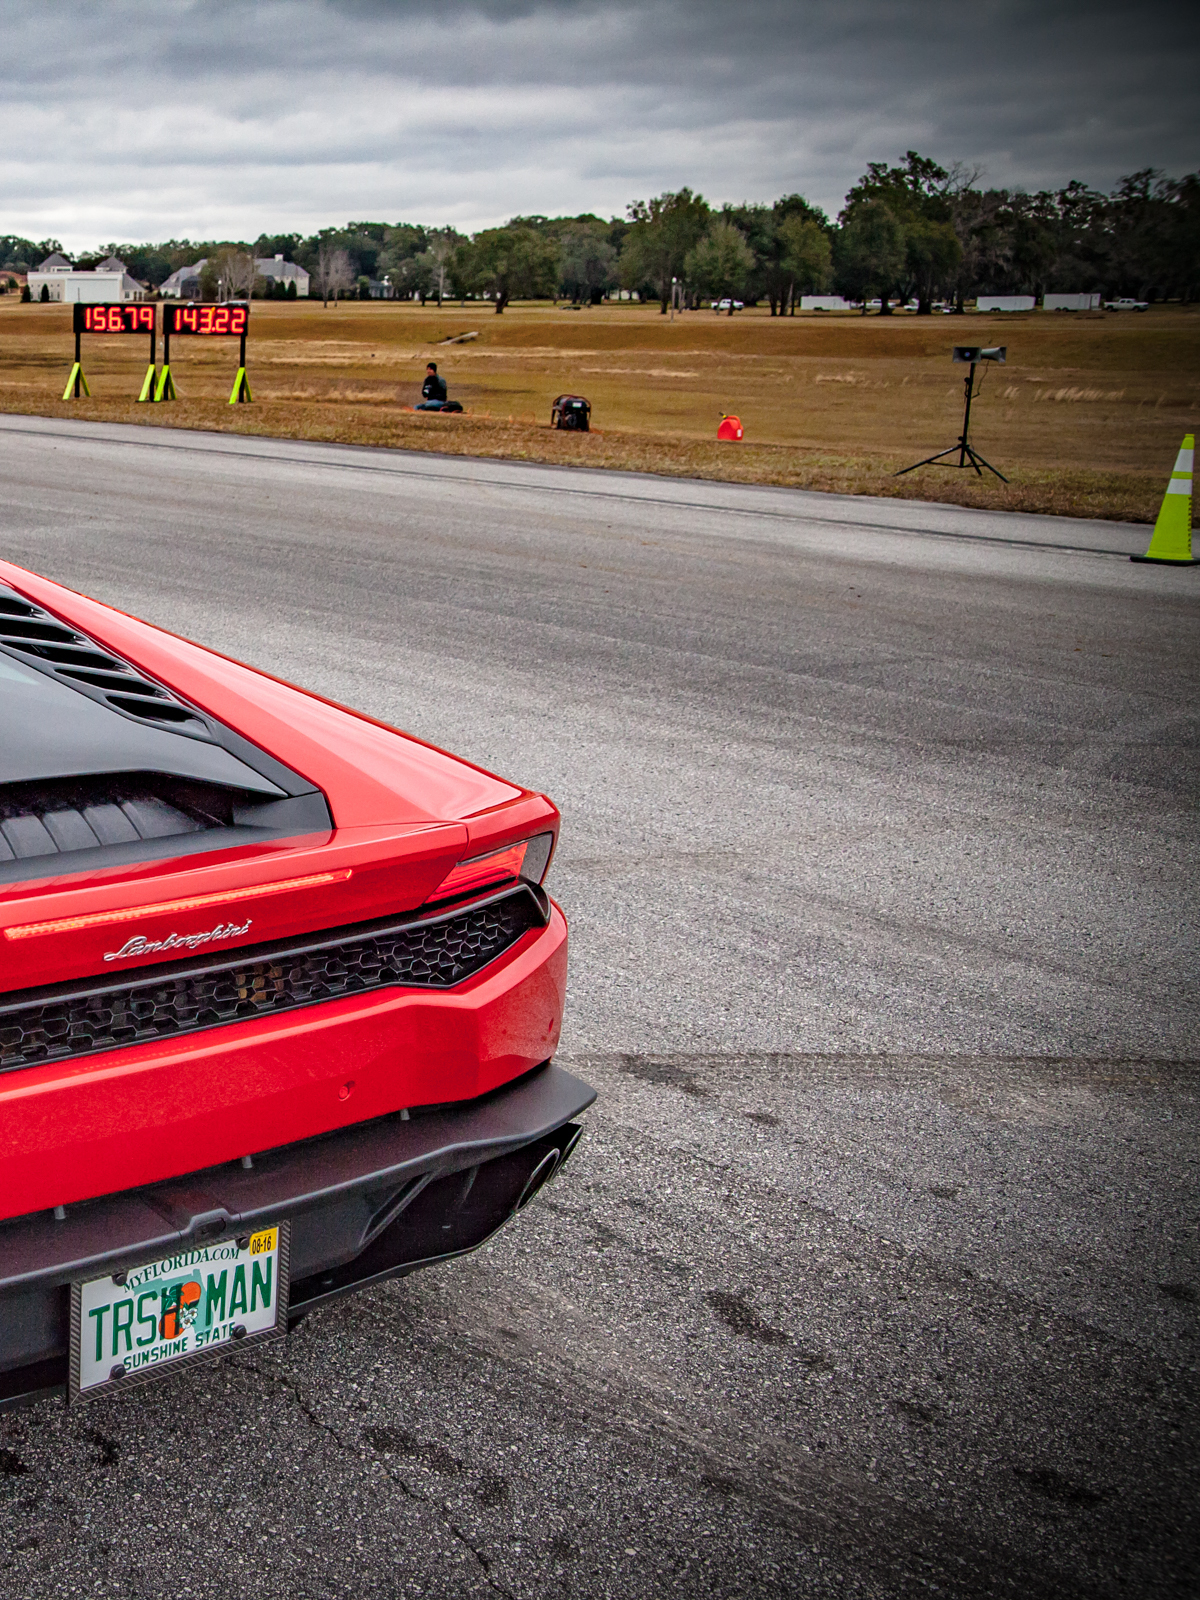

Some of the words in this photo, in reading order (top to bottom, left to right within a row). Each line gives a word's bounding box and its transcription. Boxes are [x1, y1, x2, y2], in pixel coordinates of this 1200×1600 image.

[84, 306, 155, 331] 156.79
[174, 307, 247, 333] 143.22
[103, 918, 253, 962] Lamborghini
[251, 1235, 272, 1255] 08-16
[205, 1256, 273, 1327] MAN
[123, 1339, 188, 1371] SUNSHINE
[195, 1321, 236, 1348] STATE
